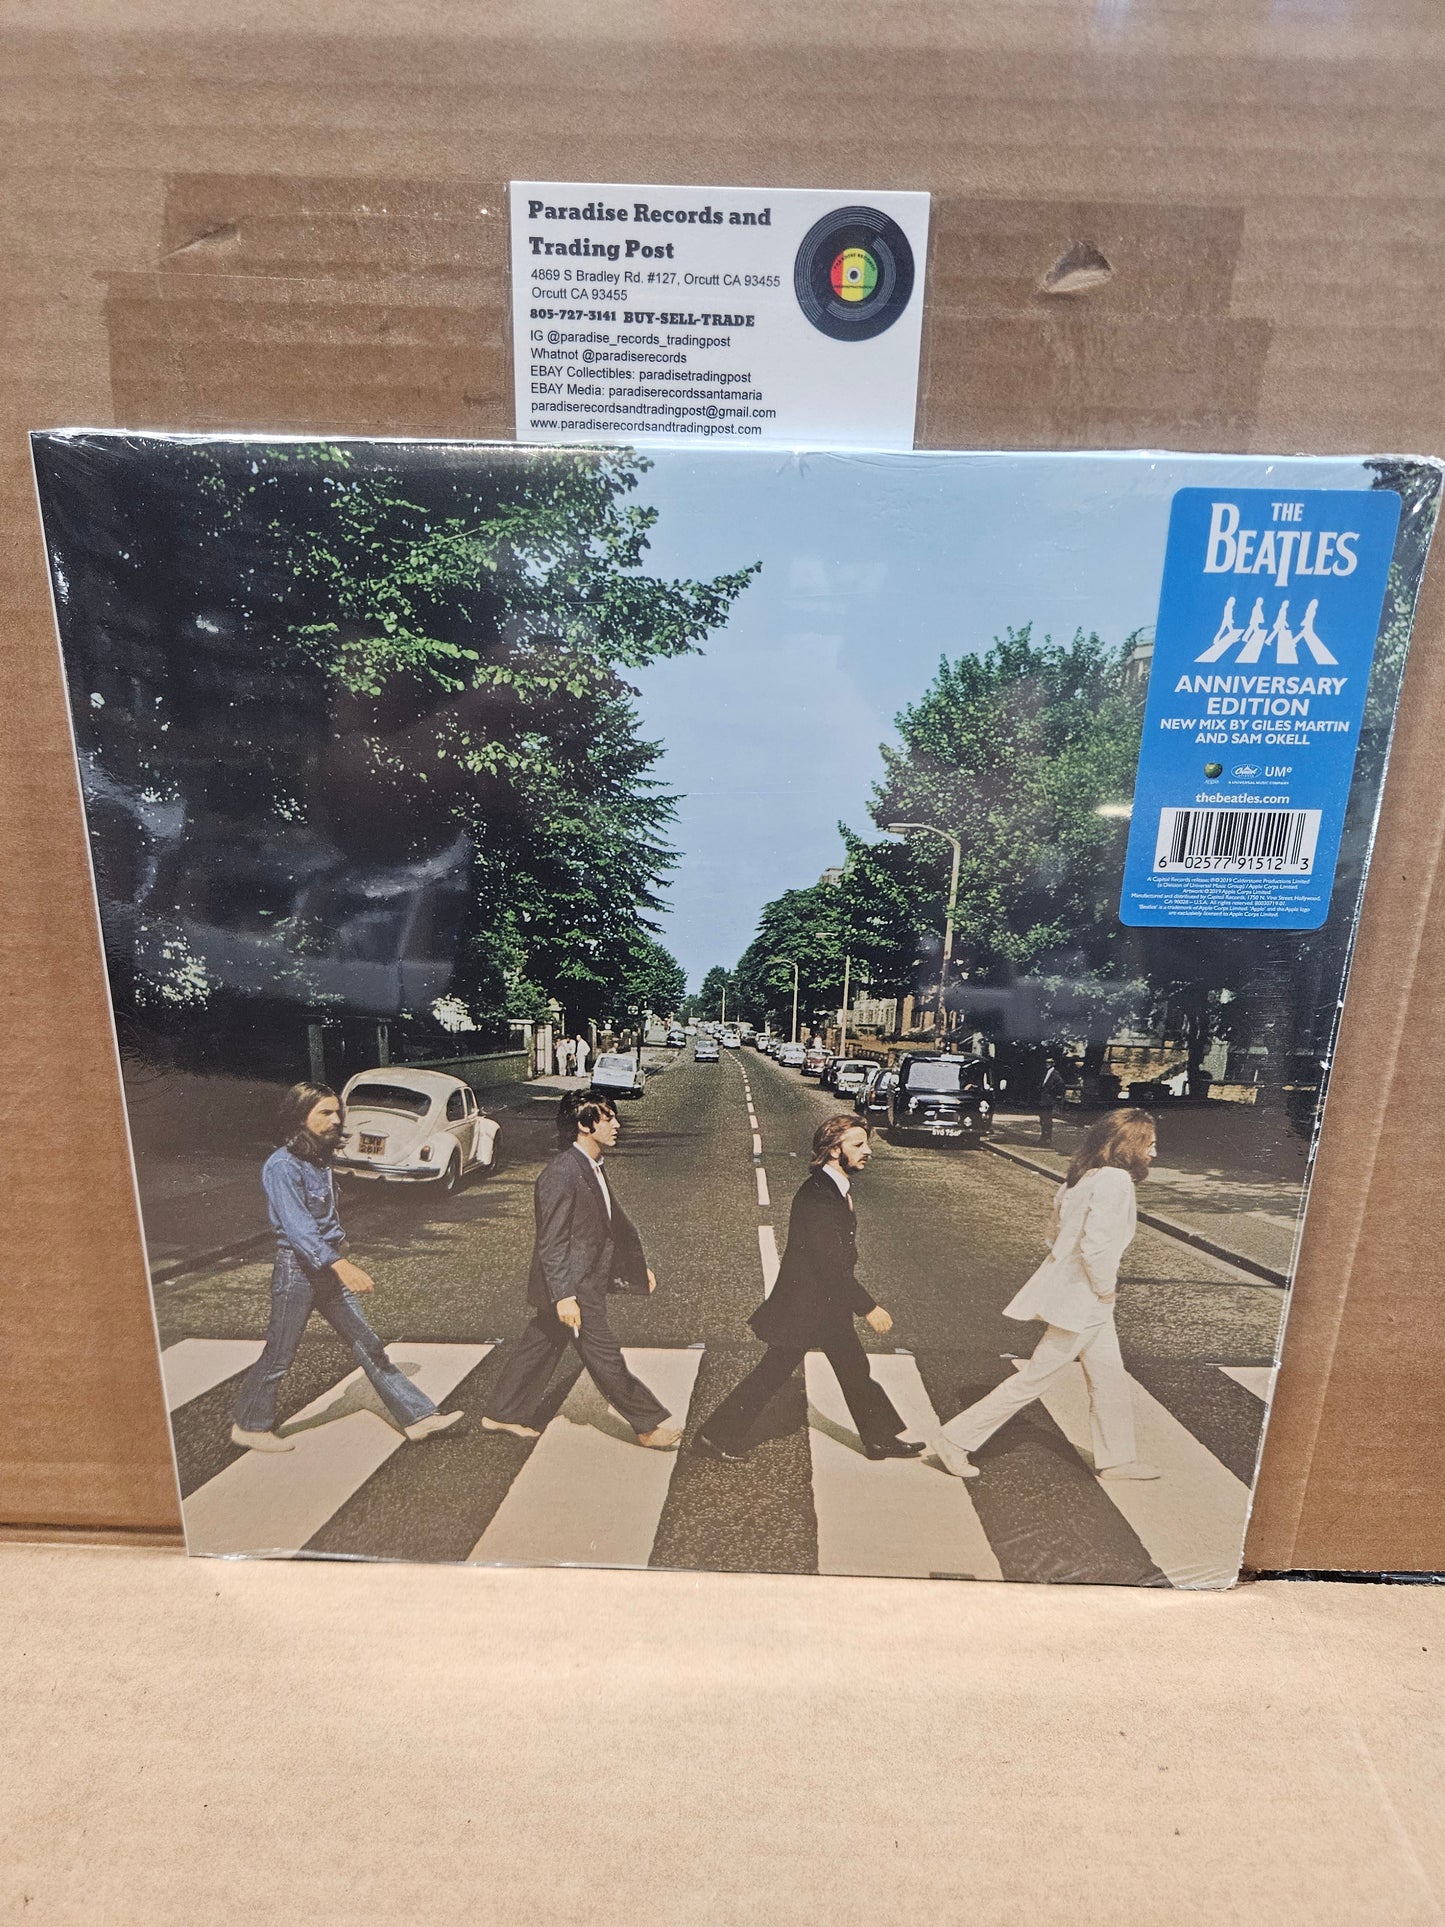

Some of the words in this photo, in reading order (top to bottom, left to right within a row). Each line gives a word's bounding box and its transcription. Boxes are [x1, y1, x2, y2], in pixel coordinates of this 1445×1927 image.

[528, 200, 628, 221] Paradise
[634, 204, 723, 224] Records
[729, 208, 771, 226] and
[529, 237, 620, 261] Trading
[625, 240, 674, 259] Post
[531, 269, 560, 280] 4869
[564, 269, 572, 281] S
[577, 270, 620, 285] Bradley
[625, 271, 643, 283] Rd.
[648, 272, 679, 286] #127,
[684, 273, 719, 285] Orcutt
[724, 274, 741, 286] CA
[745, 275, 780, 287] 93455
[532, 287, 567, 299] Orcutt
[571, 288, 589, 299] CA
[592, 289, 627, 301] 93455
[530, 309, 616, 321] 805-727-3141
[624, 312, 755, 327] BUY-SELL-TRADE
[531, 330, 543, 341] IG
[548, 331, 730, 349] @paradise_records_tradingpost
[531, 348, 578, 360] Whatnot
[582, 349, 687, 363] @paradiserecords
[531, 365, 563, 377] EBAY
[567, 366, 634, 379] Collectibles:
[640, 370, 751, 385] paradisetradingpost
[531, 382, 563, 394] EBAY
[567, 384, 604, 395] Media:
[609, 384, 762, 400] paradiserecordssantamaria
[532, 401, 776, 420] paradiserecordsandtradingpost@gmail.com
[530, 418, 761, 436] www.paradiserecordsandtradingpost.com
[1272, 503, 1304, 521] THE
[1203, 503, 1360, 587] BEATLES
[1175, 675, 1347, 695] ANNIVERSARY
[1207, 697, 1309, 716] EDITION
[1161, 719, 1196, 729] NEW
[1199, 719, 1226, 730] MIX
[1230, 720, 1249, 730] BY
[1252, 720, 1291, 731] GILES
[1295, 721, 1350, 732] MARTIN
[1195, 733, 1228, 743] AND
[1232, 733, 1260, 744] SAM
[1265, 734, 1310, 744] OKELL
[1196, 792, 1289, 803] thebeatles.com
[1158, 855, 1168, 870] 6
[1184, 855, 1231, 871] 02577
[1236, 855, 1283, 871] 91512
[1299, 858, 1310, 871] 3
